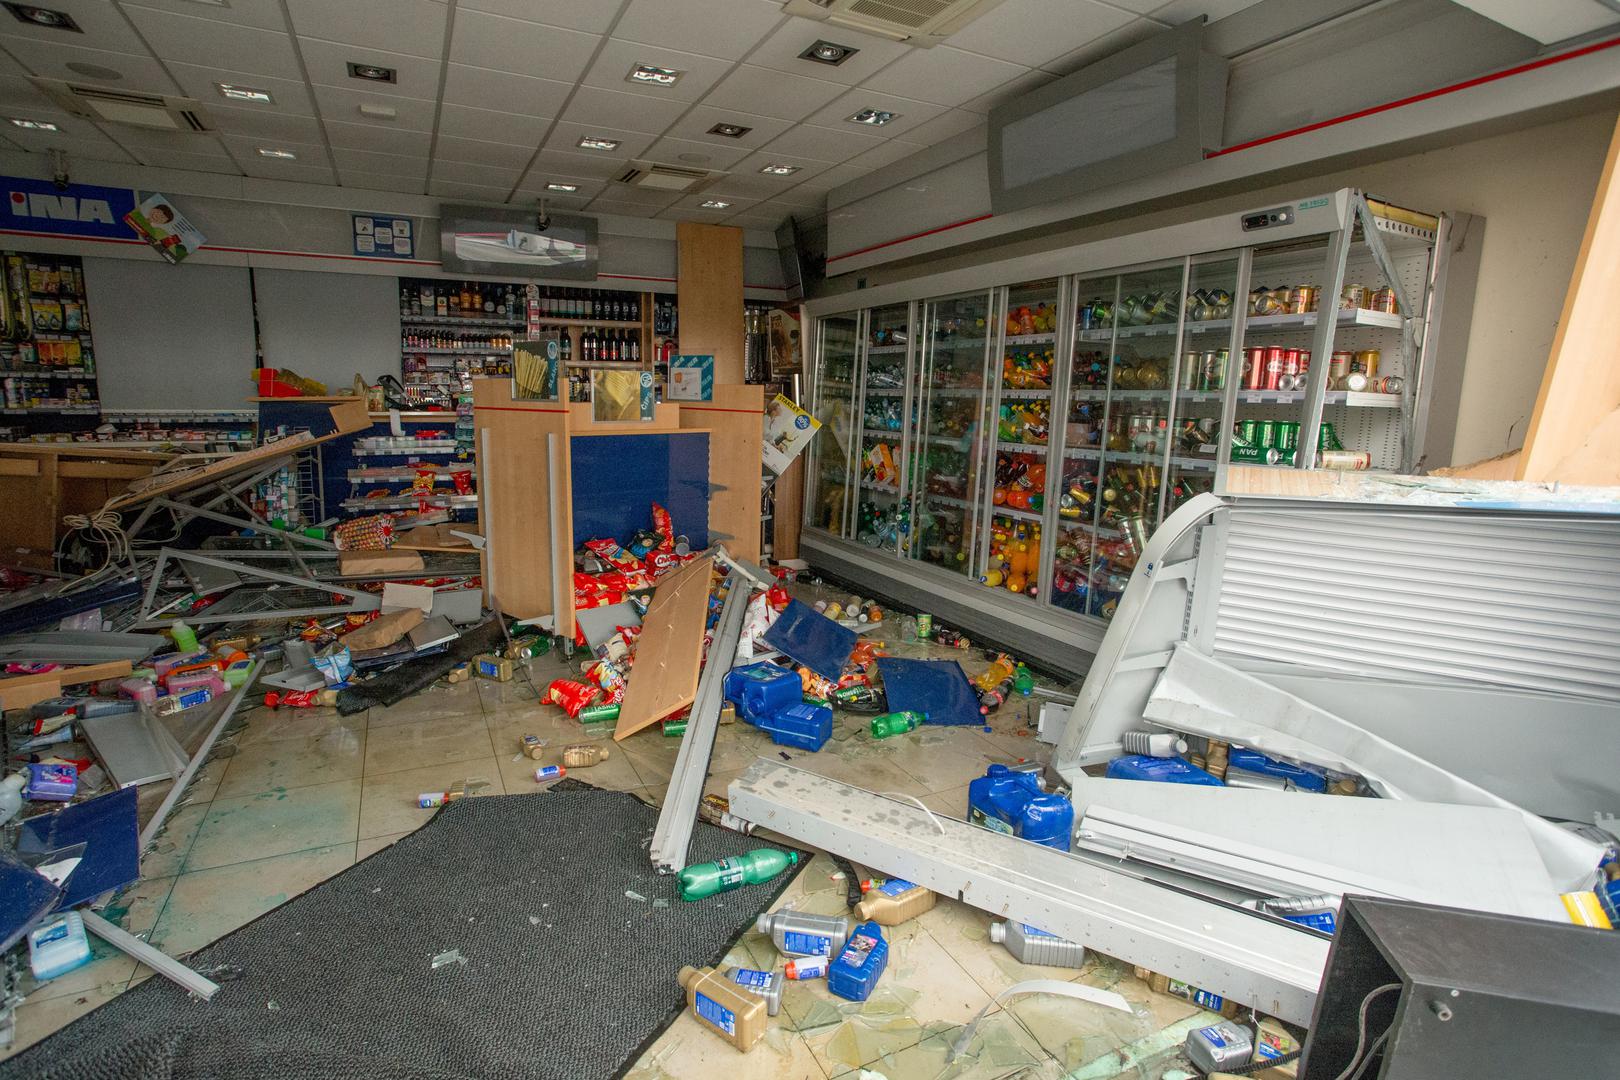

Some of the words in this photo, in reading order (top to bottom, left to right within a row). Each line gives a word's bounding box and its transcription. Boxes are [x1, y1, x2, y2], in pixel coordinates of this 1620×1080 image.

[9, 191, 116, 225] INA
[777, 395, 801, 413] STANLEY
[1239, 448, 1258, 456] PAN
